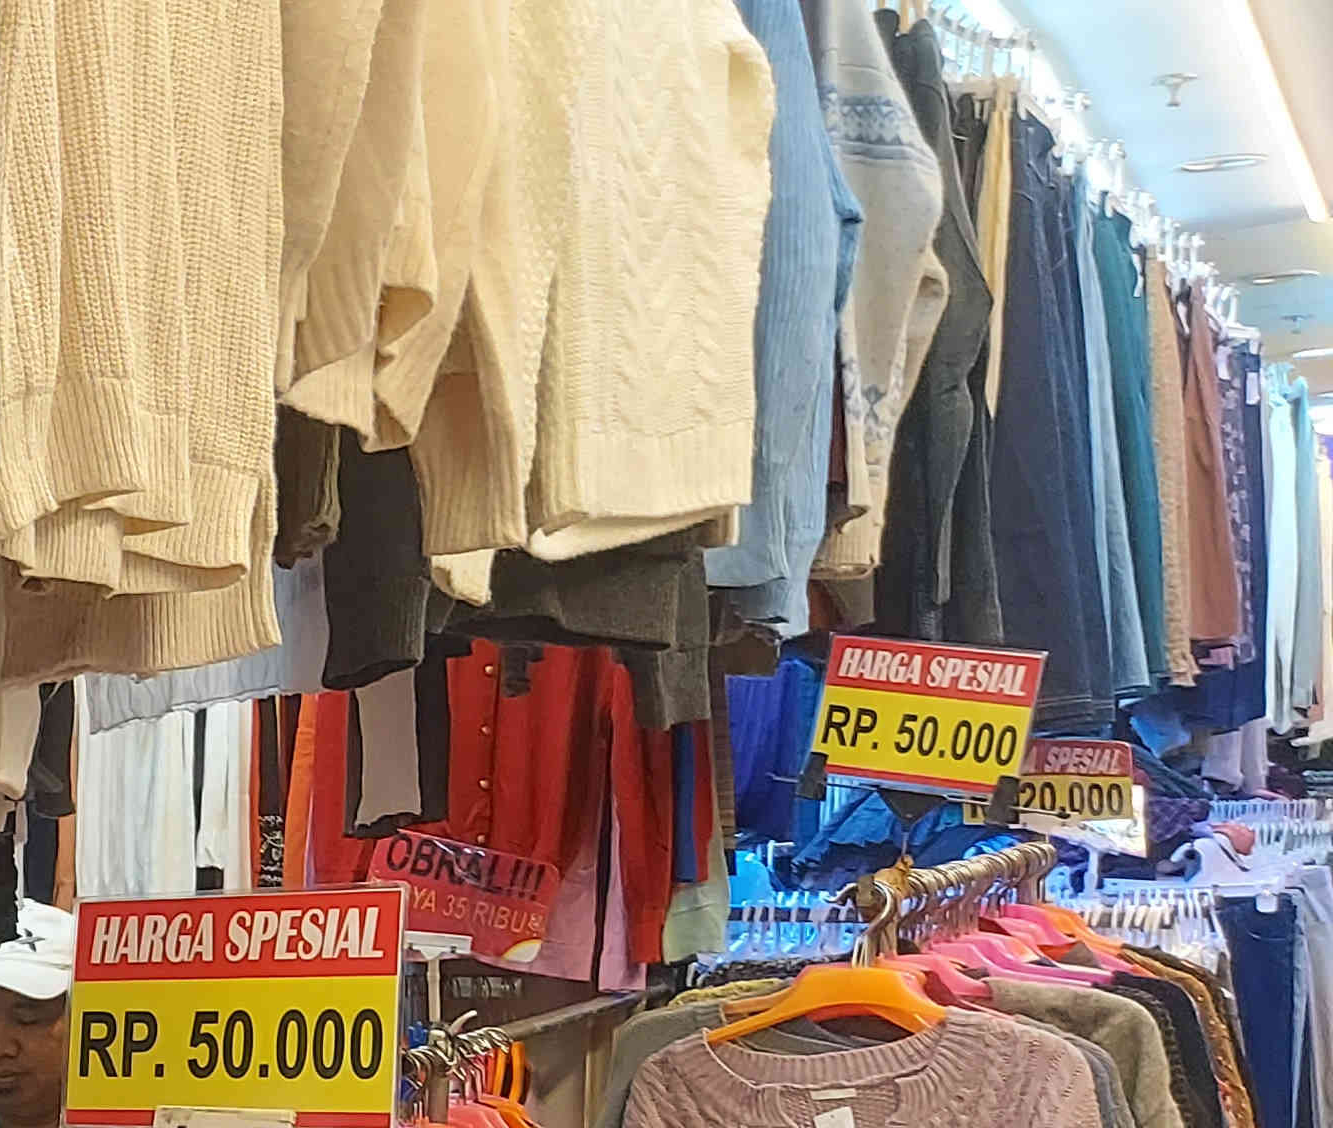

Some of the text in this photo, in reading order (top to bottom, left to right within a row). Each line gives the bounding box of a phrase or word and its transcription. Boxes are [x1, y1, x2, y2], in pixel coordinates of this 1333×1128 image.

[838, 647, 1028, 696] HARGA SPESIAL
[821, 705, 879, 750] RP.
[893, 714, 1017, 766] 50.000
[1044, 746, 1121, 773] SPESIAL
[386, 833, 546, 902] OBRAL!!!
[90, 907, 383, 964] HARGA SPESIAL
[442, 895, 468, 920] 35
[78, 1008, 383, 1080] RP. 50.000
